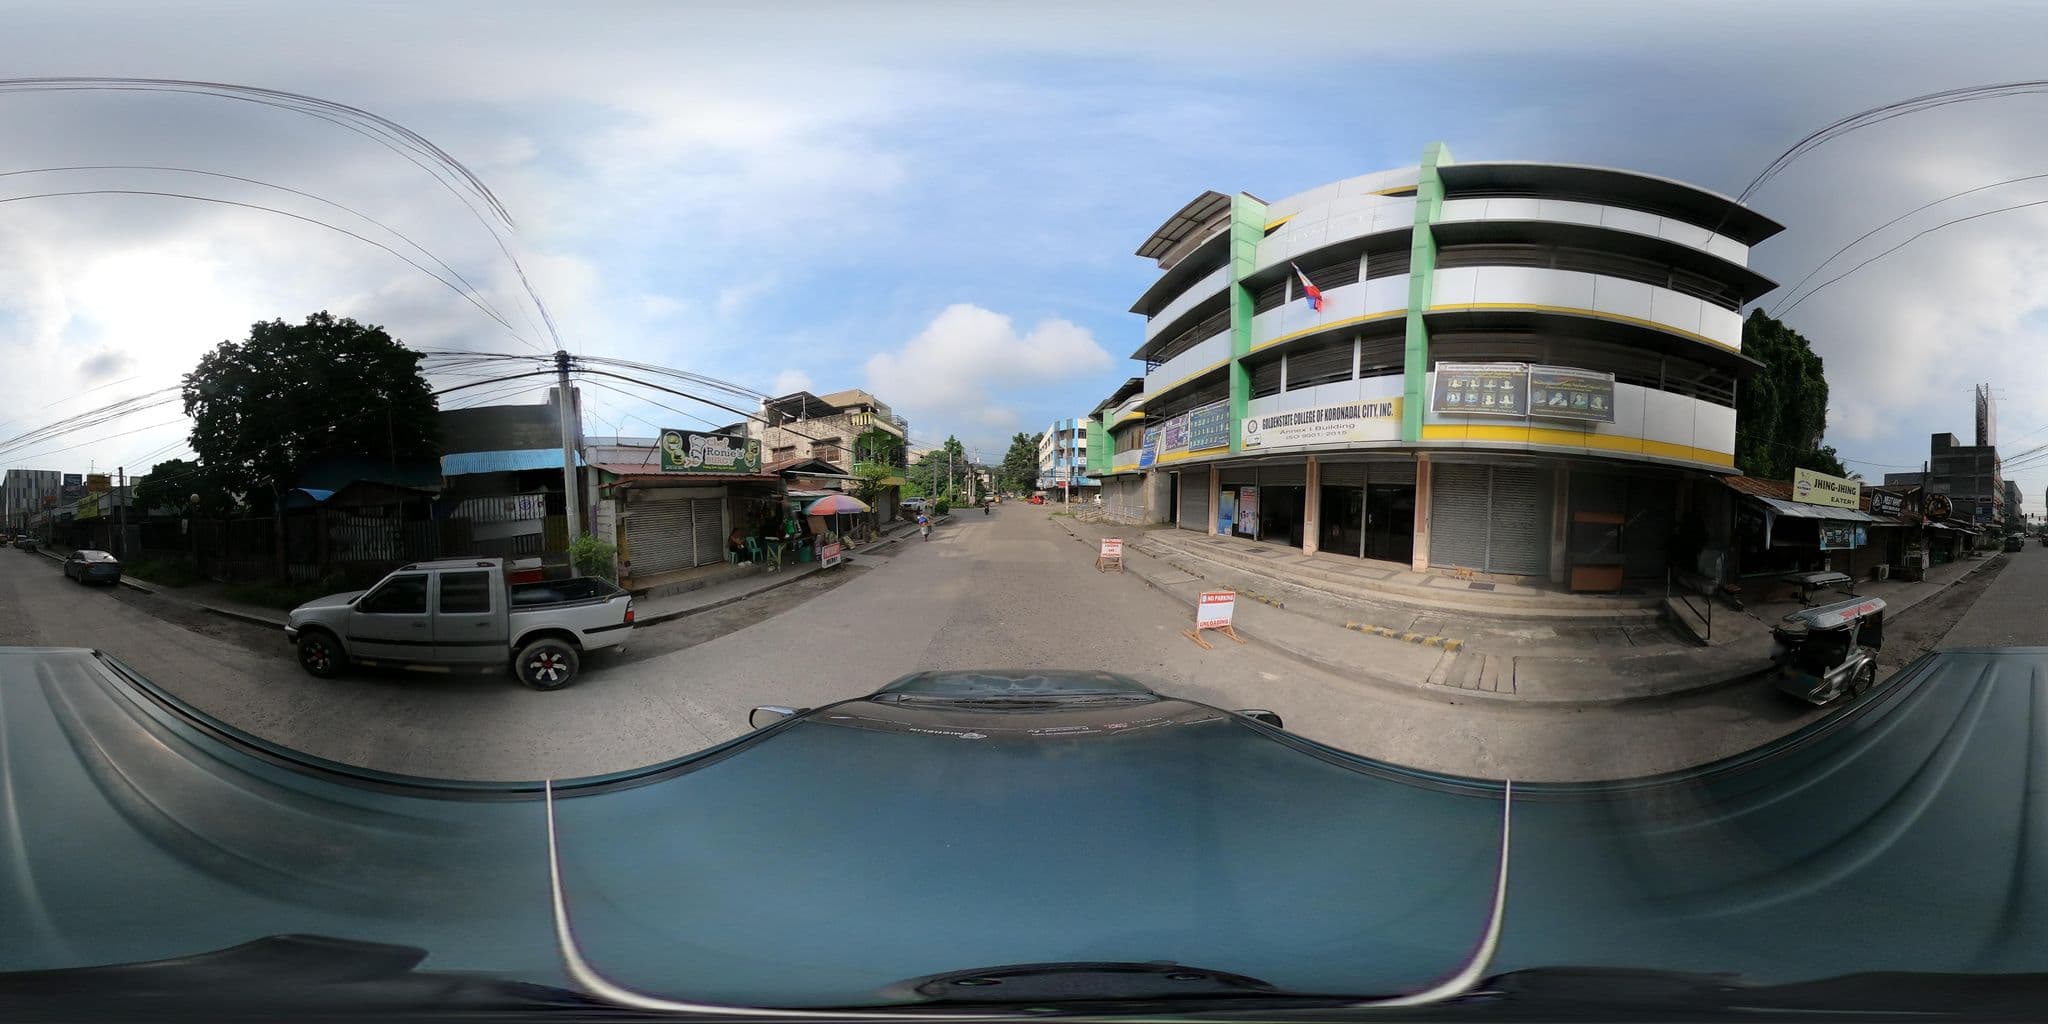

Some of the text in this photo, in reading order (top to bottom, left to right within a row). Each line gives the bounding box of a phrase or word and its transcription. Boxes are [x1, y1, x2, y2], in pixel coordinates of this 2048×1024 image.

[1262, 413, 1293, 430] GOLDENSTATE
[1293, 410, 1316, 425] COLLEGE
[1317, 409, 1323, 423] OF
[1324, 404, 1360, 421] KORONADAL
[1380, 402, 1393, 417] INC.
[1315, 423, 1356, 432] Building
[706, 437, 729, 448] Chef
[1814, 478, 1857, 496] JHING-JHING
[1831, 496, 1855, 505] EATERY
